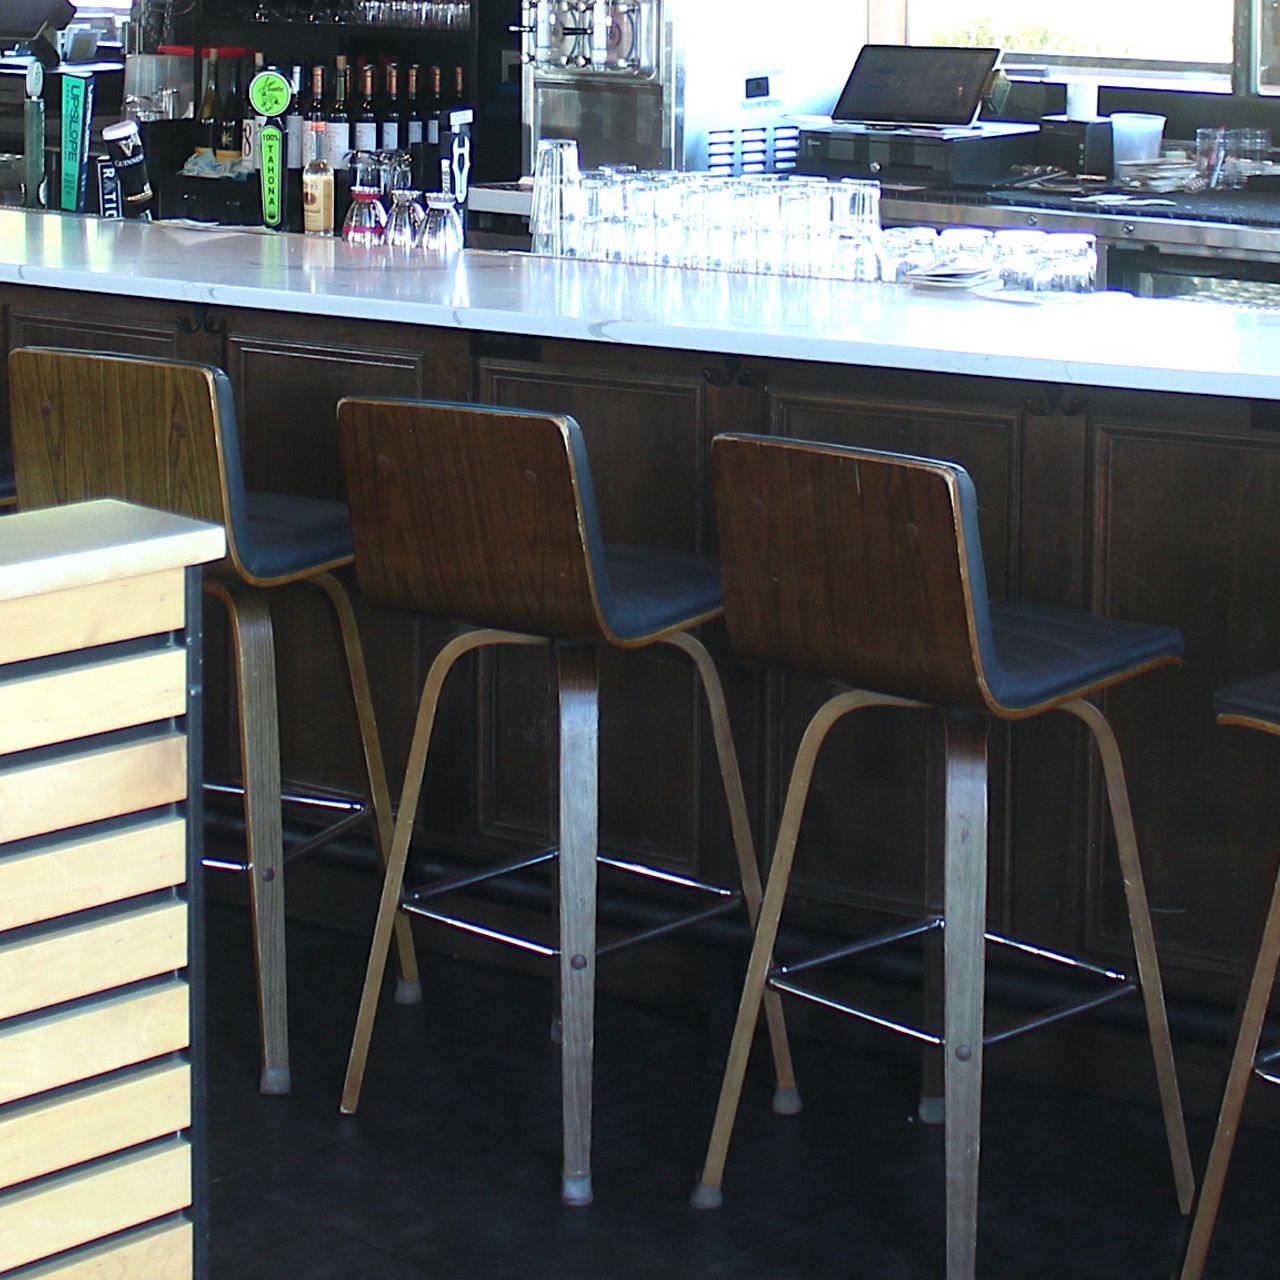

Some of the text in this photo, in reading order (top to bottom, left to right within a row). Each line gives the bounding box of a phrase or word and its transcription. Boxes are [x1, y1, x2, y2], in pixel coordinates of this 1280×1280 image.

[70, 84, 80, 164] UPSLOPE
[262, 133, 280, 142] 100%
[267, 144, 276, 206] TAHONA
